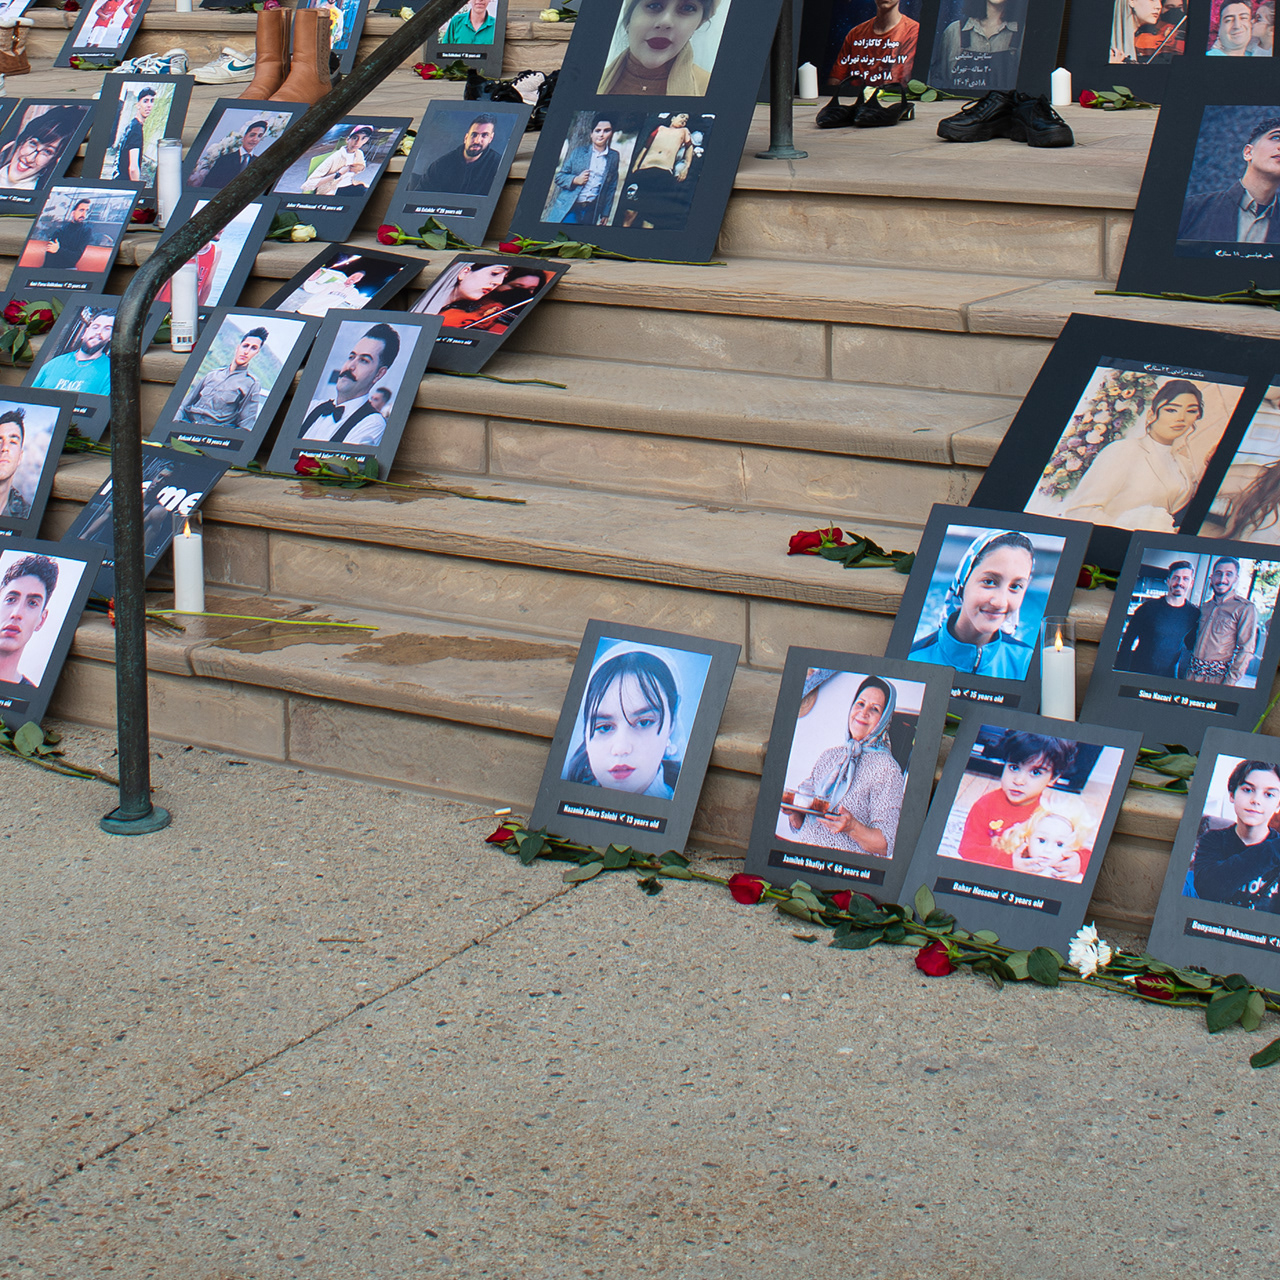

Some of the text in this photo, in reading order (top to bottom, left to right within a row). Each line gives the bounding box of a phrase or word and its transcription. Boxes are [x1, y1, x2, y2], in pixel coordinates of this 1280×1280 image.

[55, 378, 84, 391] PEACE
[1188, 699, 1206, 708] years
[1205, 701, 1217, 711] old
[584, 807, 600, 818] Zahra
[633, 818, 649, 827] years
[649, 820, 660, 829] old
[843, 867, 860, 877] years
[860, 869, 871, 880] old
[952, 881, 972, 893] Bahar
[1008, 893, 1015, 903] 3
[1014, 896, 1032, 906] years
[1032, 899, 1045, 909] old
[1225, 927, 1267, 945] Mohammadi
